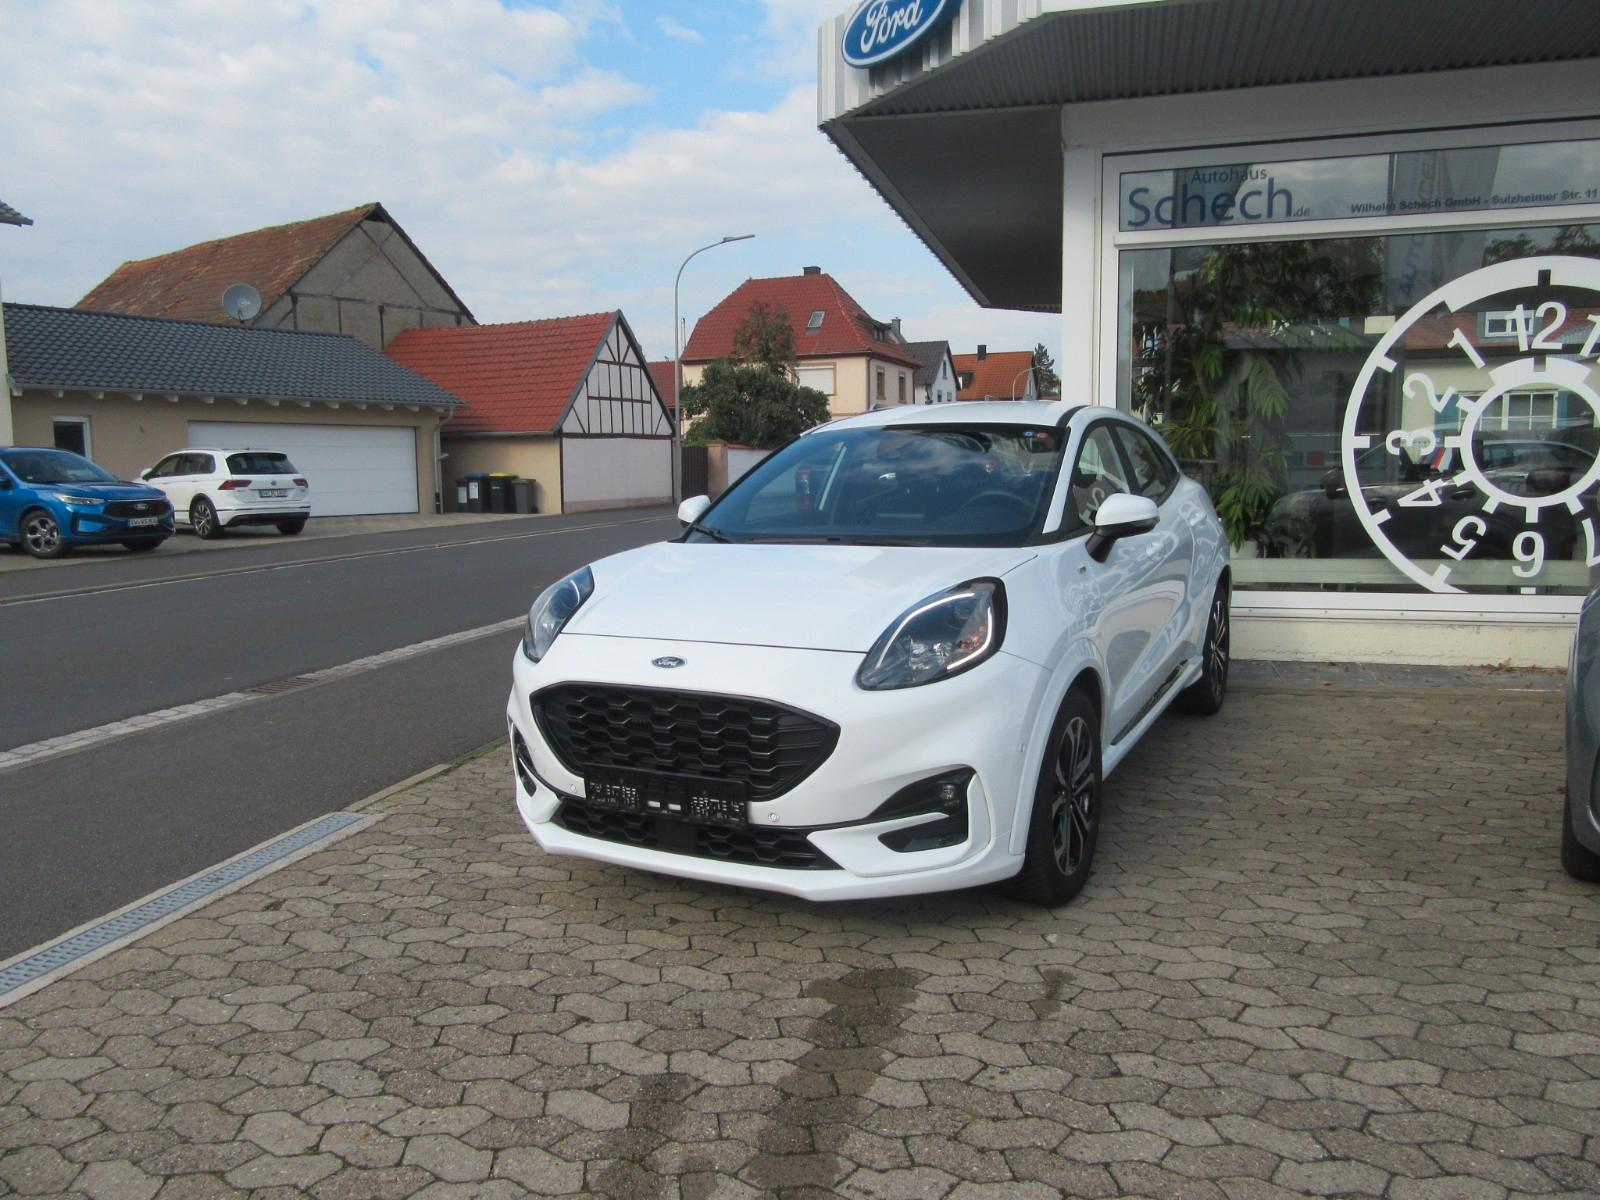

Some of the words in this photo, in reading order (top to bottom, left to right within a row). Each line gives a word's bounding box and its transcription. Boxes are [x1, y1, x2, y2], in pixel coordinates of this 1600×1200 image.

[861, 0, 924, 53] Ford
[1190, 168, 1268, 184] Autohaus
[1351, 202, 1396, 213] Wilhelm
[1400, 199, 1441, 210] Schech
[1444, 196, 1481, 207] GmbH
[1491, 192, 1558, 205] Sulzheimer
[1561, 189, 1582, 200] Str.
[1505, 301, 1567, 352] 12
[1447, 328, 1486, 369] 1
[1402, 372, 1456, 413] 2
[1385, 429, 1436, 456] 3
[1397, 478, 1443, 507] 4
[1440, 515, 1487, 561] 5
